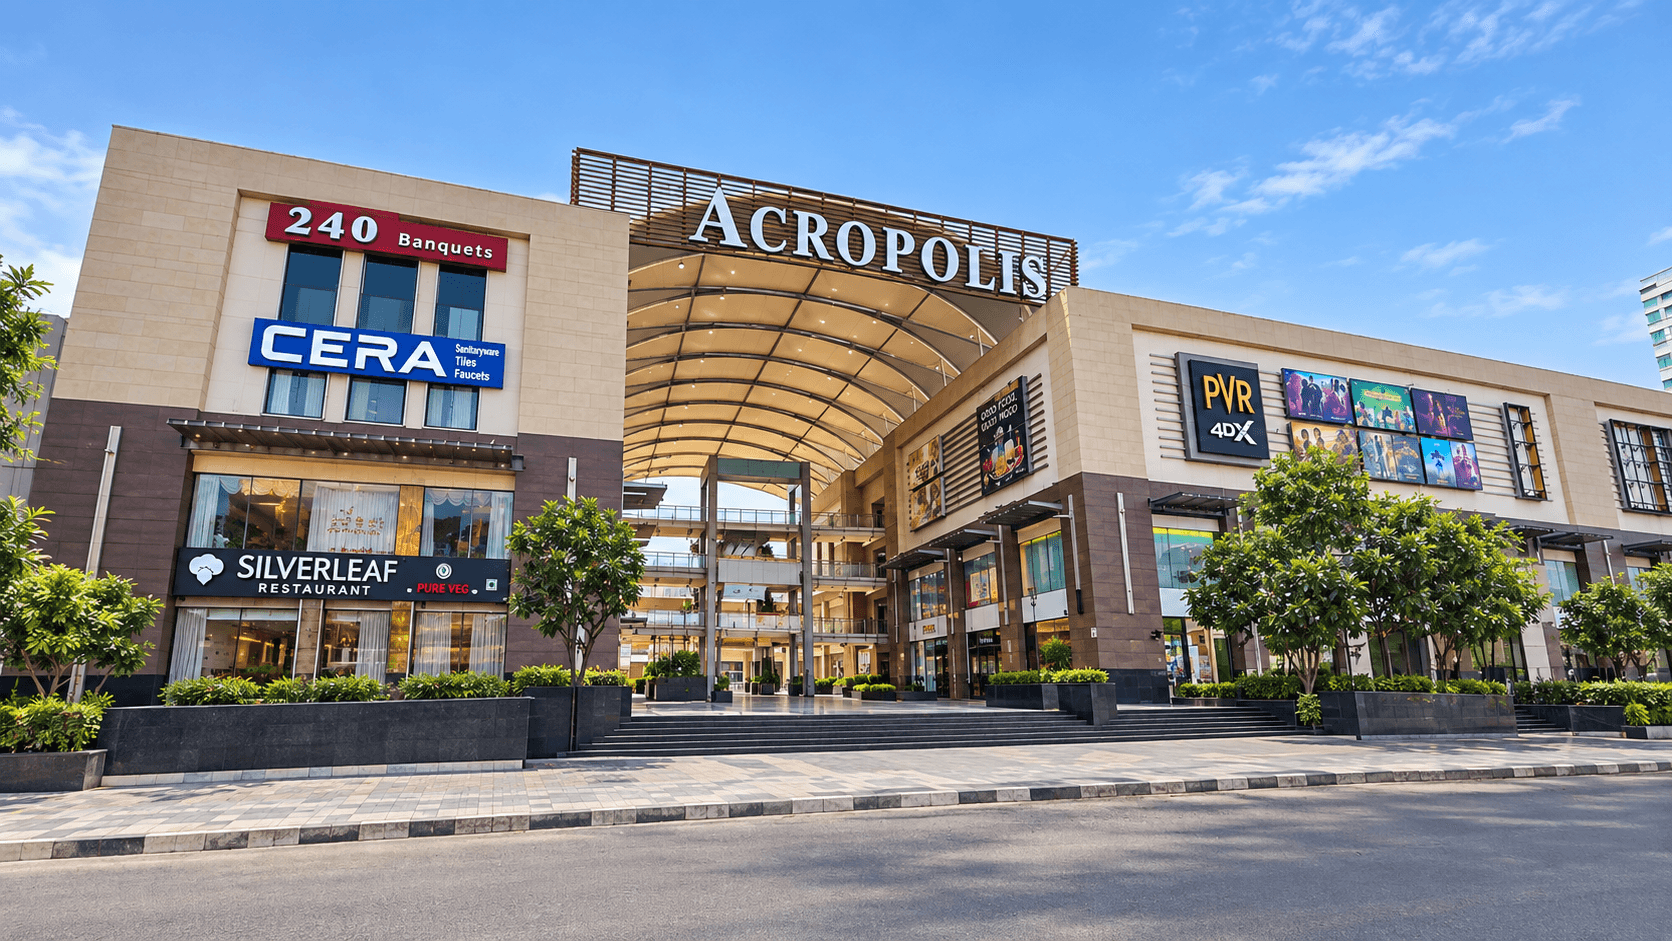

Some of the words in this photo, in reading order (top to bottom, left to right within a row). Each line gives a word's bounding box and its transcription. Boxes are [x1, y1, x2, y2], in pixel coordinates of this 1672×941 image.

[285, 206, 378, 243] 240
[399, 232, 493, 260] Banquets
[688, 186, 1047, 299] ACROPOLIS
[261, 324, 447, 377] CERA
[455, 343, 500, 358] Sanitaryware
[455, 356, 477, 367] Tiles
[454, 368, 490, 381] Faucets
[1203, 373, 1255, 414] PVR
[1210, 420, 1258, 446] 4DX
[236, 554, 399, 583] SILVERLEAF
[258, 583, 371, 596] RESTAURANT
[417, 583, 445, 593] PURE
[448, 584, 469, 594] VEG
